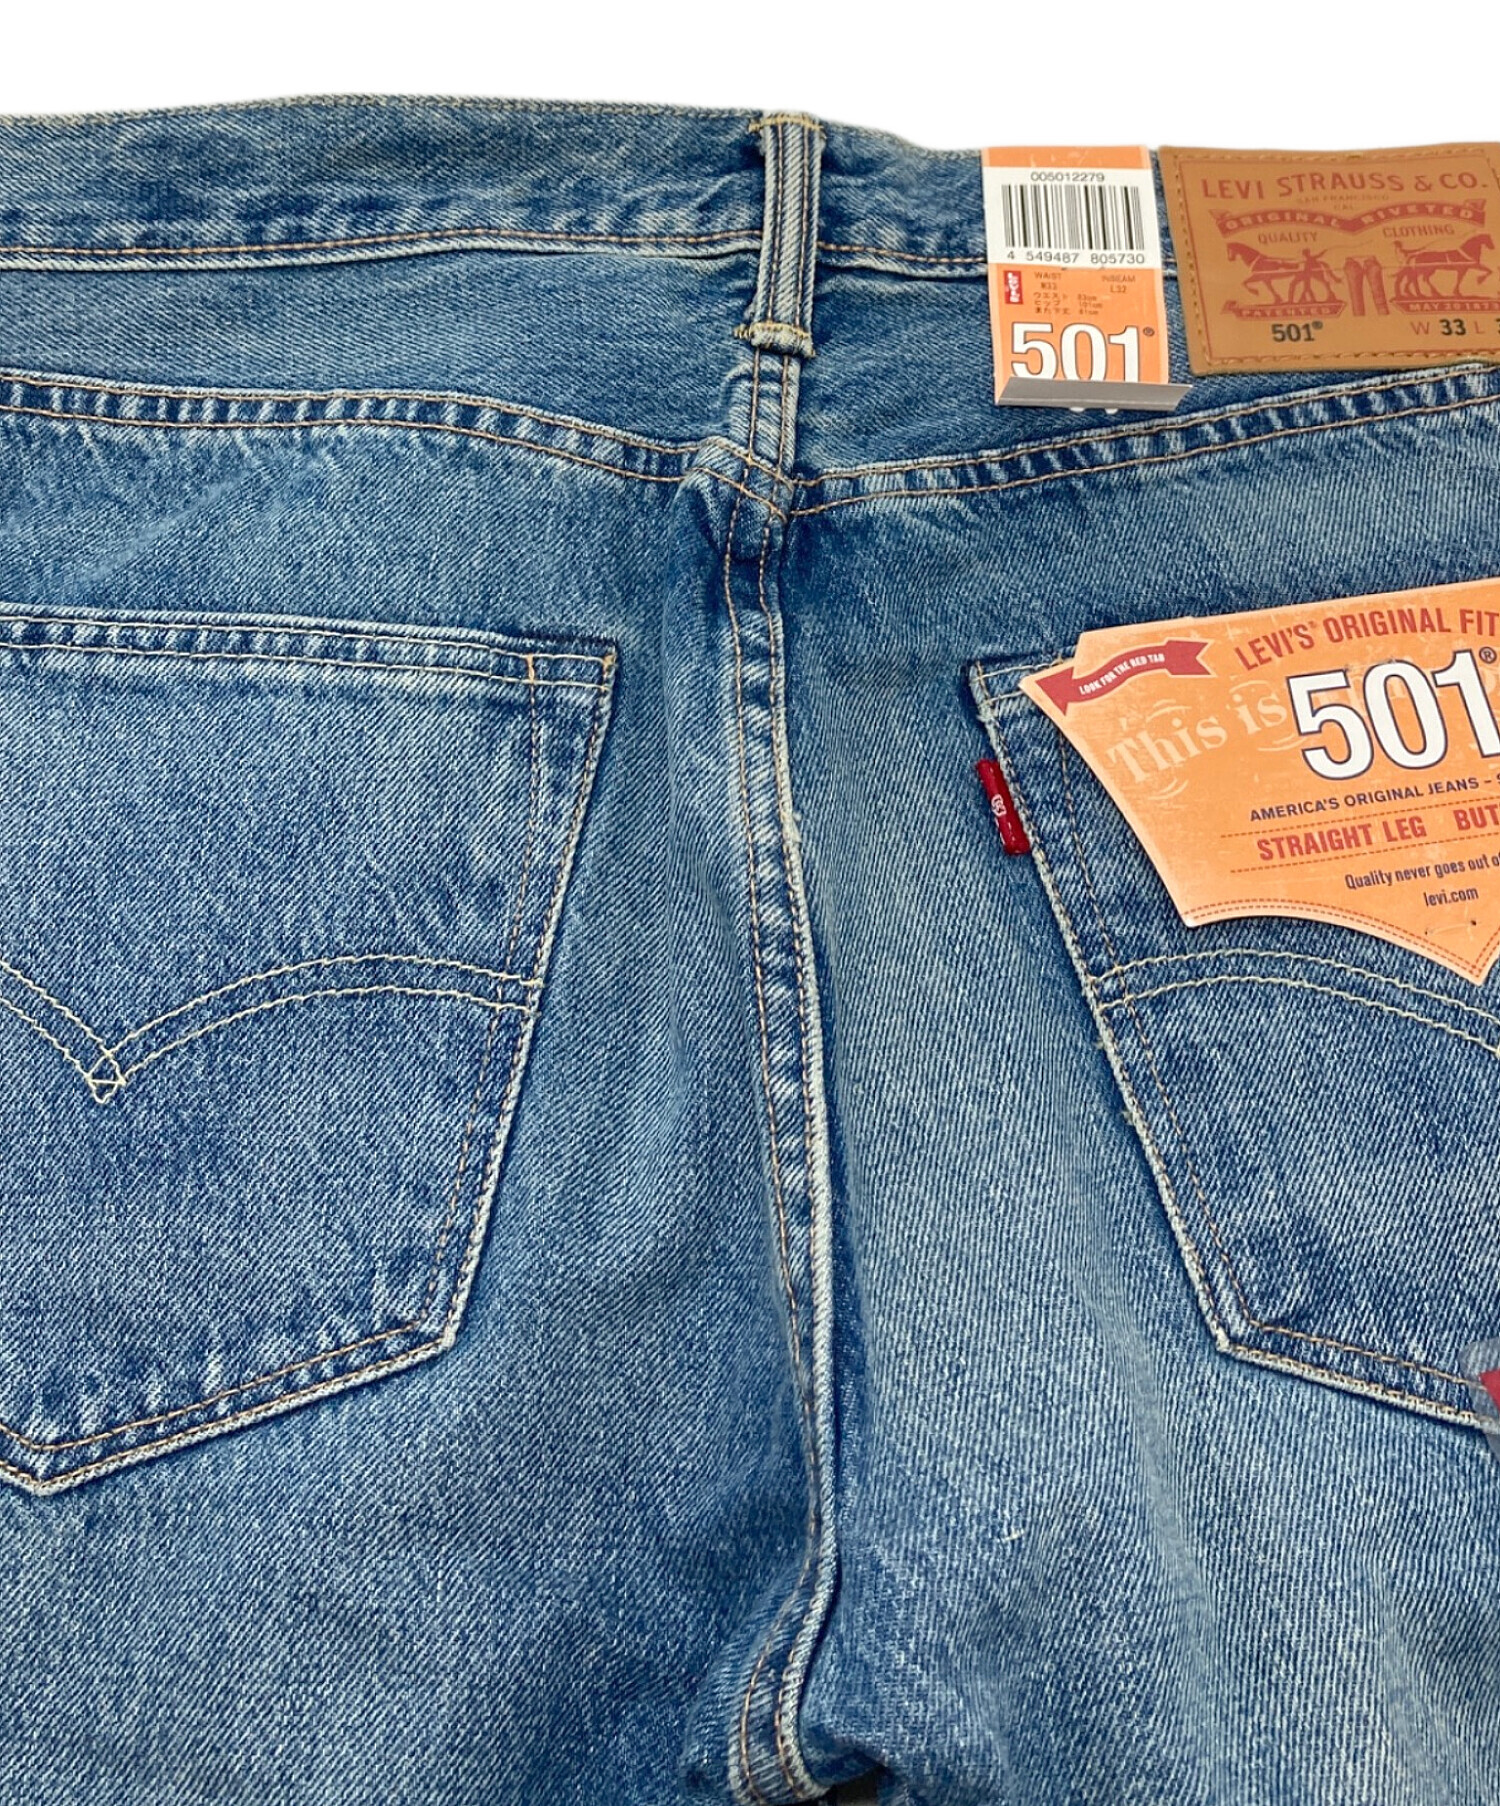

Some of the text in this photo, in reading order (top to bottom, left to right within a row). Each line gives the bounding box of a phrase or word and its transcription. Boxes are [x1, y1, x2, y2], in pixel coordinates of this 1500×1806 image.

[1030, 171, 1105, 182] 005012279
[1201, 171, 1489, 200] LEVI STRAUSS & CO.
[1225, 203, 1474, 230] ORIGINAL RIVETED
[1382, 223, 1456, 238] CLOTHING
[1257, 231, 1318, 245] QUALITY
[1006, 250, 1145, 264] 4 549487 805730
[1410, 321, 1430, 335] W
[1439, 318, 1467, 336] 33
[1474, 321, 1485, 334] L
[1323, 607, 1452, 643] ORIGINAL
[1459, 608, 1500, 637] FIT
[1078, 653, 1166, 695] LOOK FOR THE RED TAB
[1106, 692, 1288, 784] This is
[1250, 796, 1341, 822] AMERICA'S
[1343, 785, 1424, 808] ORIGINAL
[1428, 777, 1480, 796] JEANS
[1256, 803, 1500, 861] STRAIGHT LEG BUT
[1345, 853, 1500, 890] Quality never goes out o
[1423, 886, 1479, 907] levi.com
